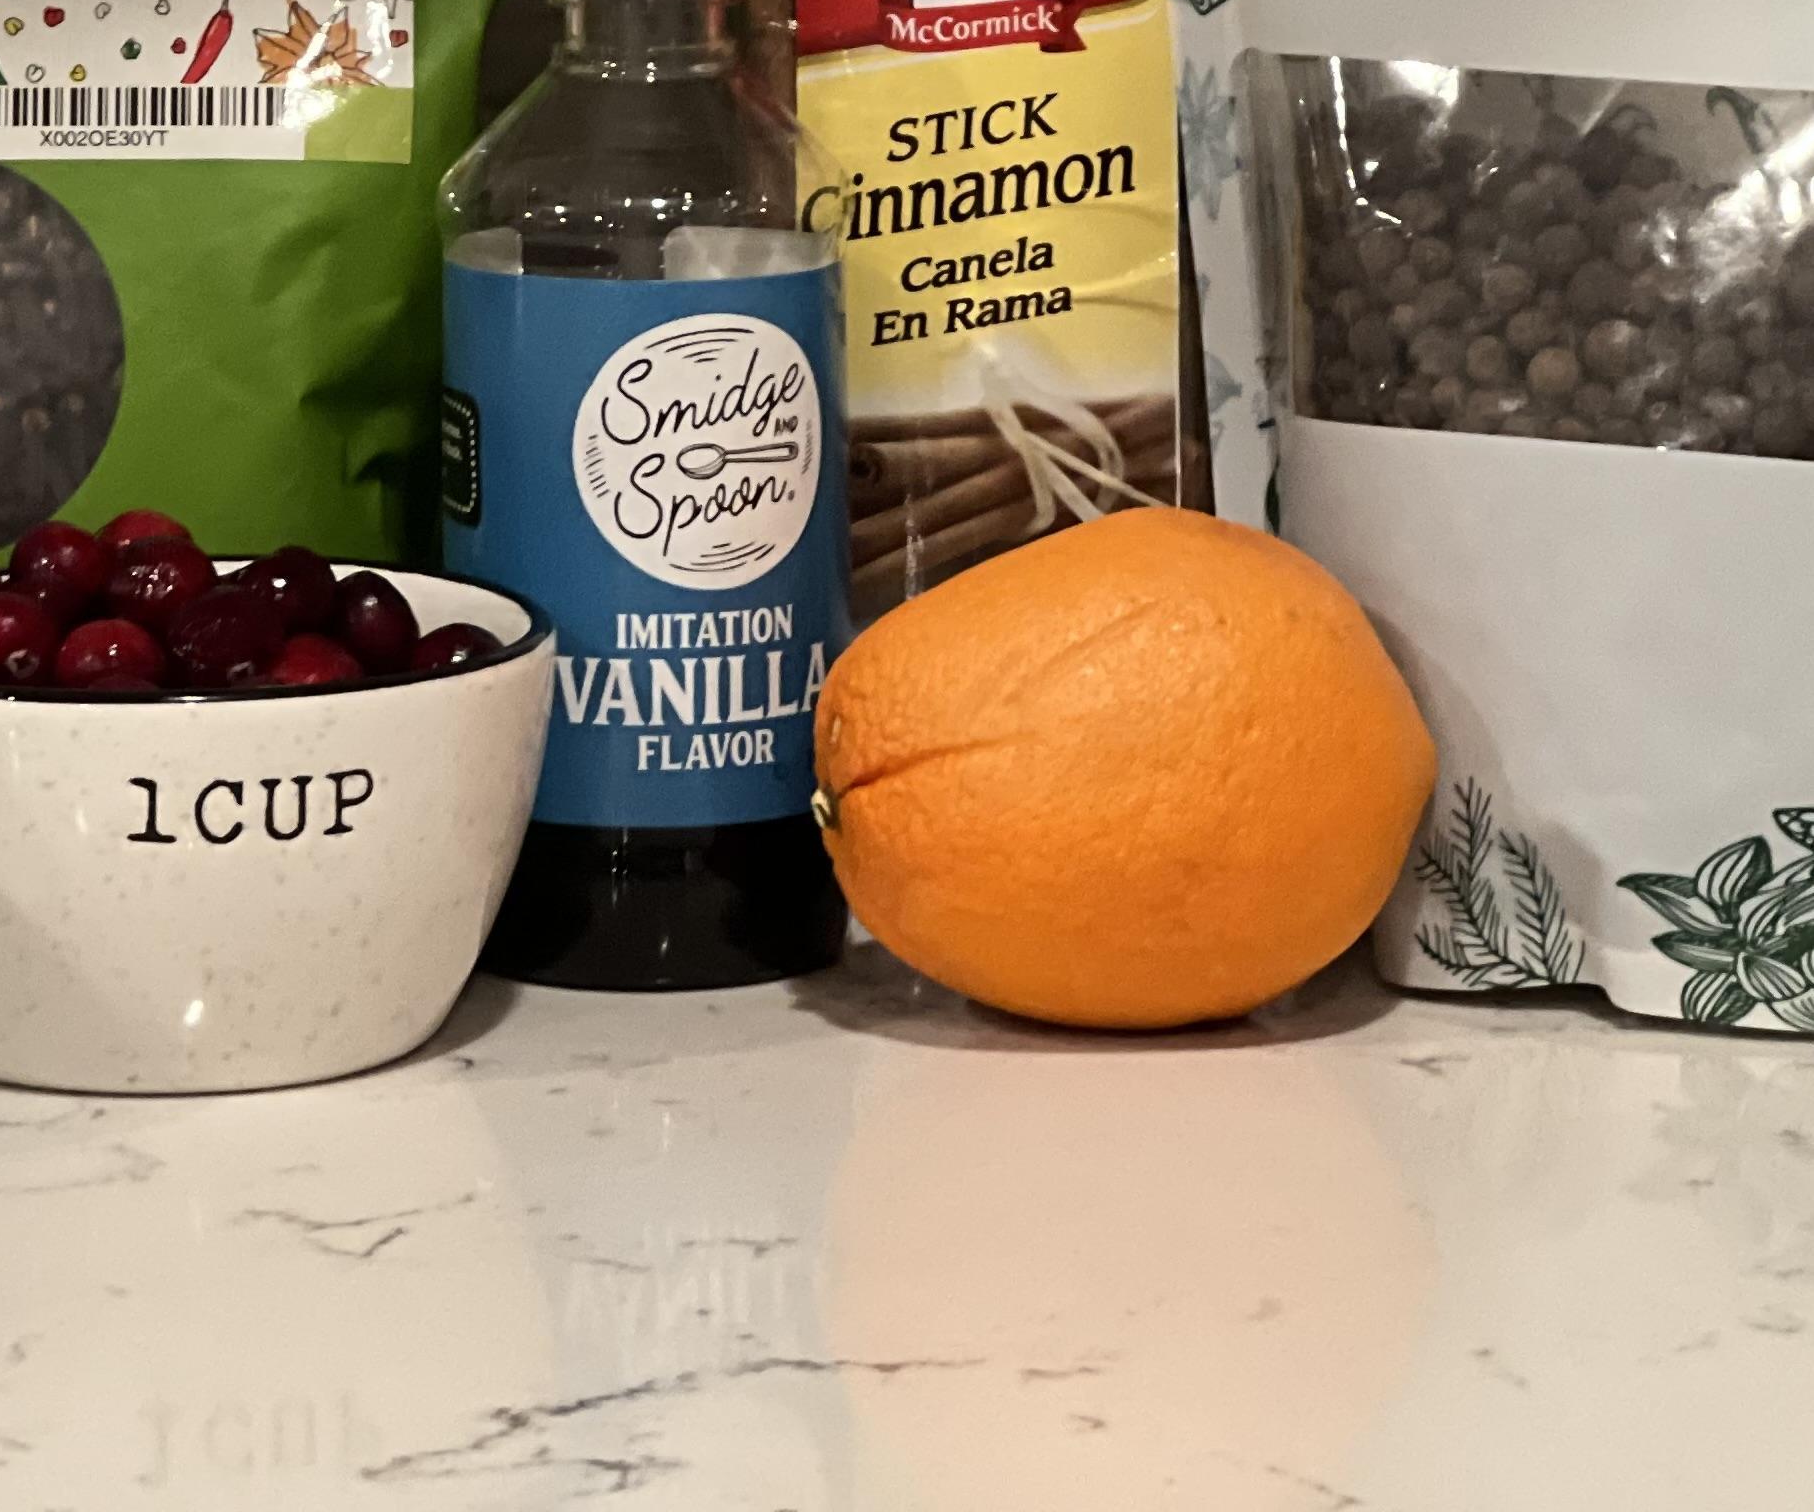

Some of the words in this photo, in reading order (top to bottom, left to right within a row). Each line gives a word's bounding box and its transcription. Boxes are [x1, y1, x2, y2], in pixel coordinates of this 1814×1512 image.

[886, 6, 1061, 44] McCormick
[887, 93, 1059, 162] STICK
[801, 144, 1137, 242] Cinnamon
[901, 236, 1054, 293] Canela
[870, 310, 928, 347] En
[943, 286, 1073, 335] Rama
[601, 348, 806, 445] Smidge
[616, 604, 793, 649] IMITATION
[557, 642, 827, 726] VANILLA
[637, 728, 776, 771] FLAVOR
